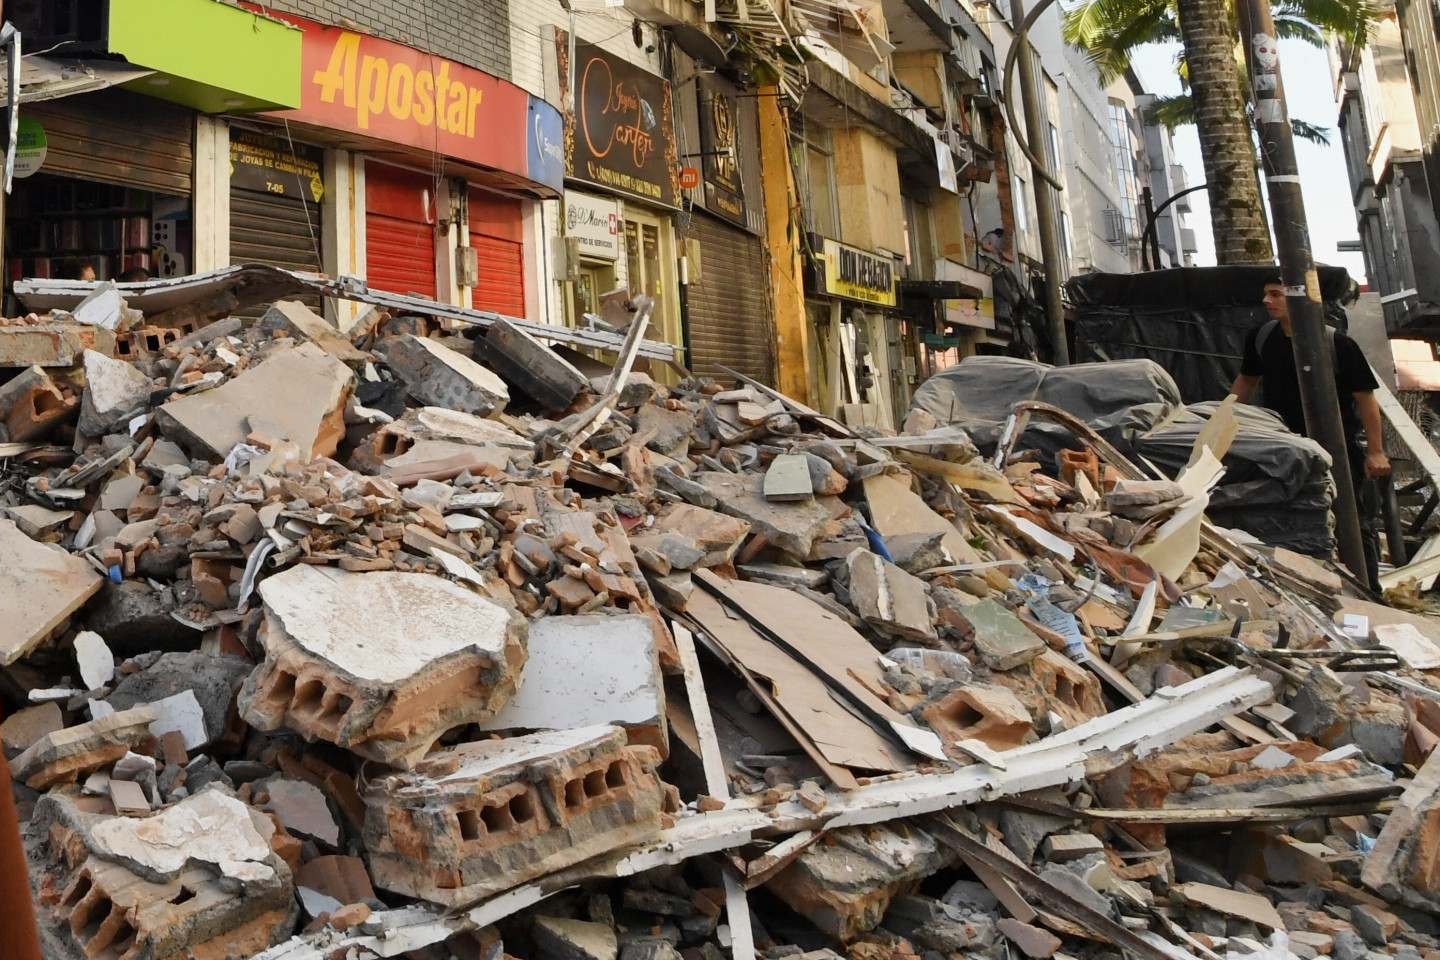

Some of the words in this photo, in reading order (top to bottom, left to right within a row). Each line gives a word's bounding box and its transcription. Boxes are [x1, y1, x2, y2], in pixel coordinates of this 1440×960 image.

[313, 31, 482, 139] Apostar
[241, 155, 263, 166] JOYAS
[266, 181, 284, 194] 7-05
